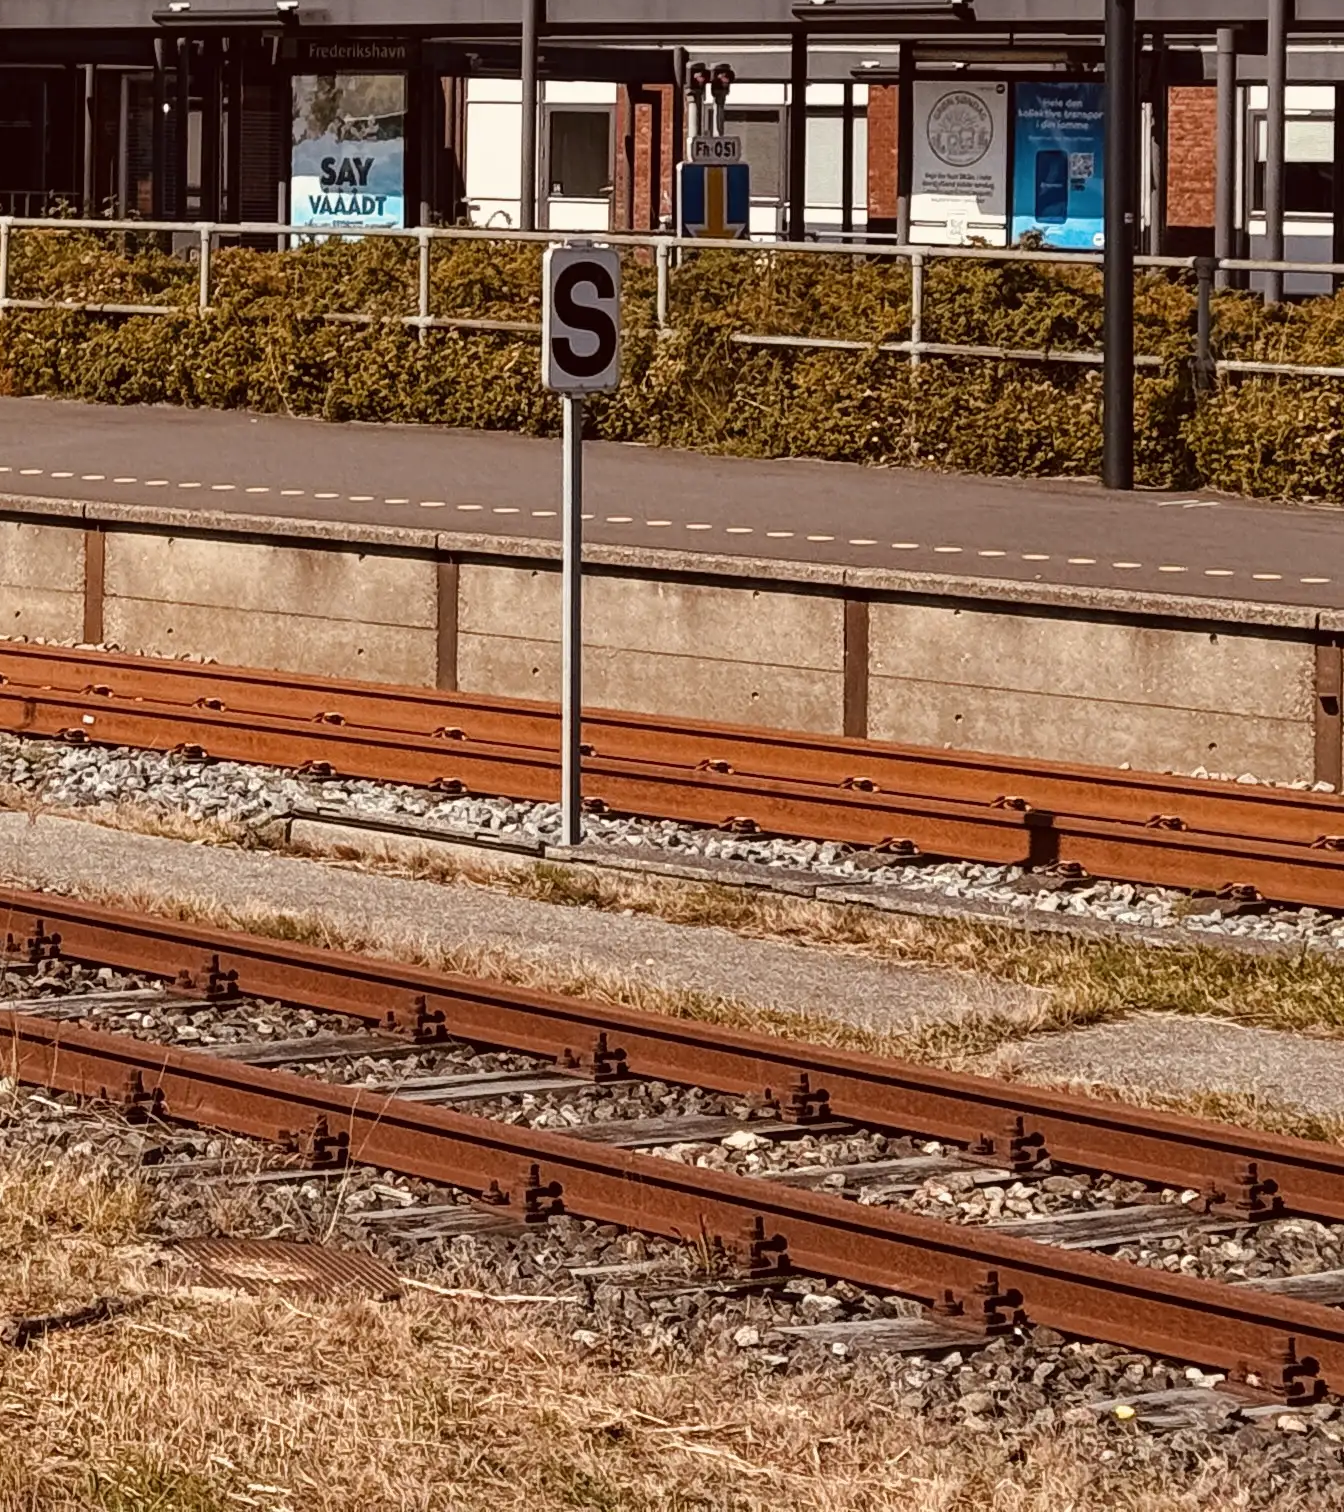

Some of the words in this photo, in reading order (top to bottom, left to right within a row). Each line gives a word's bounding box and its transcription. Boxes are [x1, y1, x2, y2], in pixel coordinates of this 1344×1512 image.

[309, 42, 406, 58] Frederikshavn
[1064, 109, 1104, 120] transpor
[320, 157, 375, 186] SAY
[552, 261, 617, 377] S
